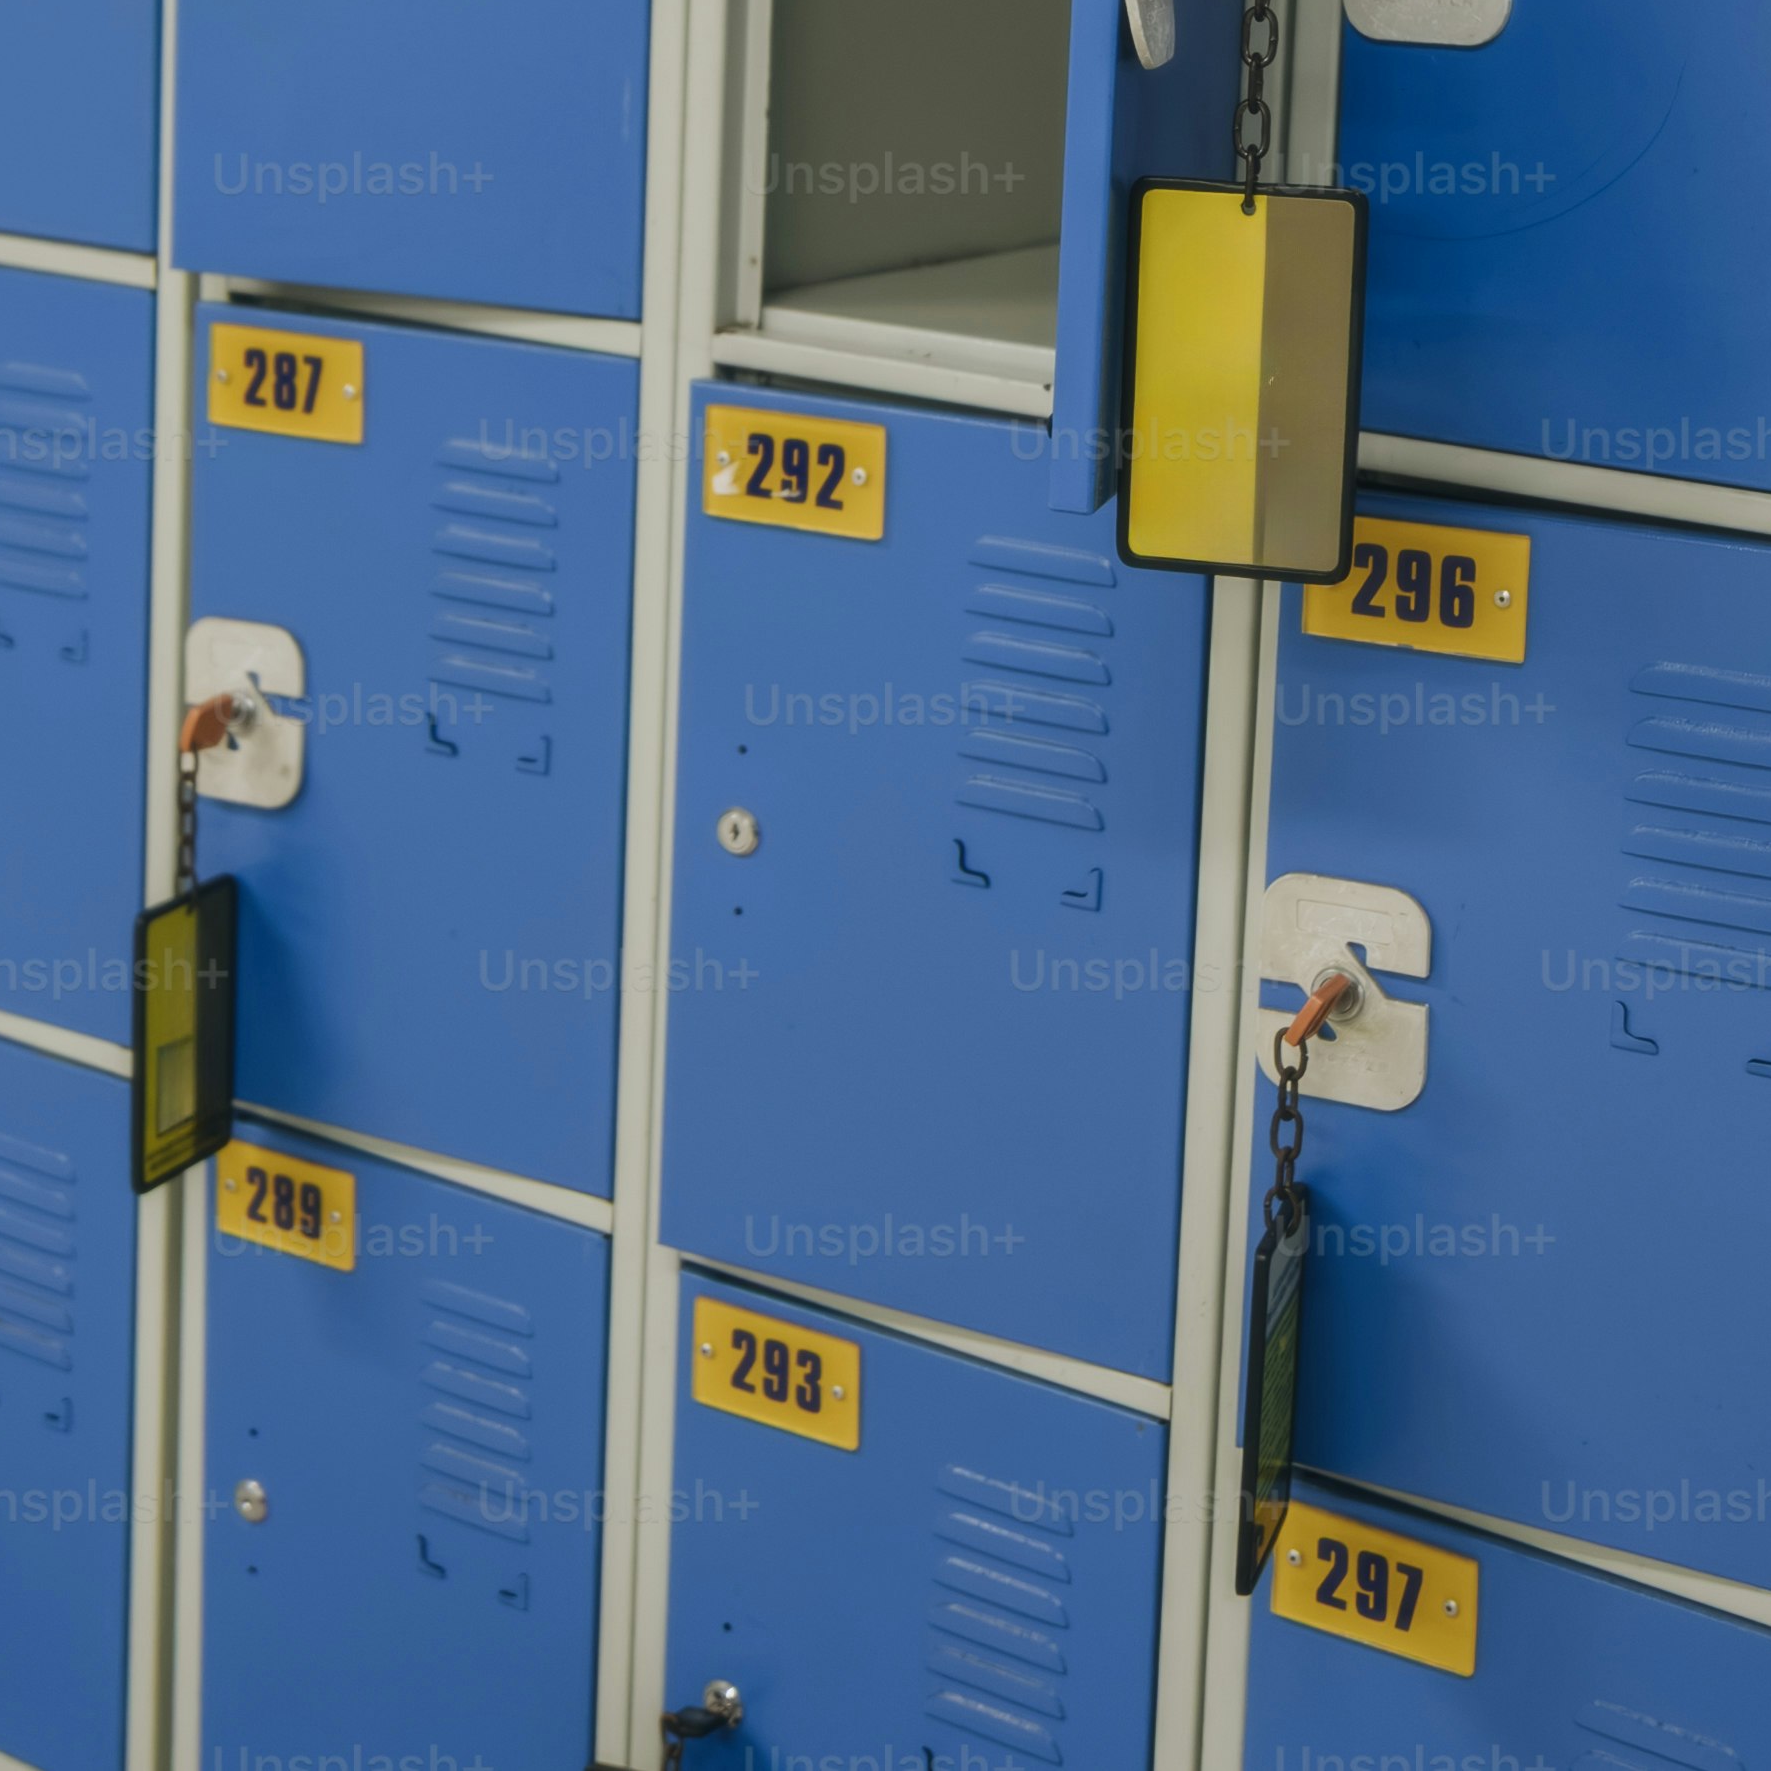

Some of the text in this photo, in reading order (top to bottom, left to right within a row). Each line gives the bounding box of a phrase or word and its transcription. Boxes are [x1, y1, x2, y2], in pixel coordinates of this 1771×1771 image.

[245, 348, 323, 414] 287
[746, 433, 845, 510] 292
[1351, 542, 1476, 628] 296
[246, 1165, 323, 1240] 289
[730, 1328, 822, 1414] 293
[1315, 1536, 1423, 1632] 297
